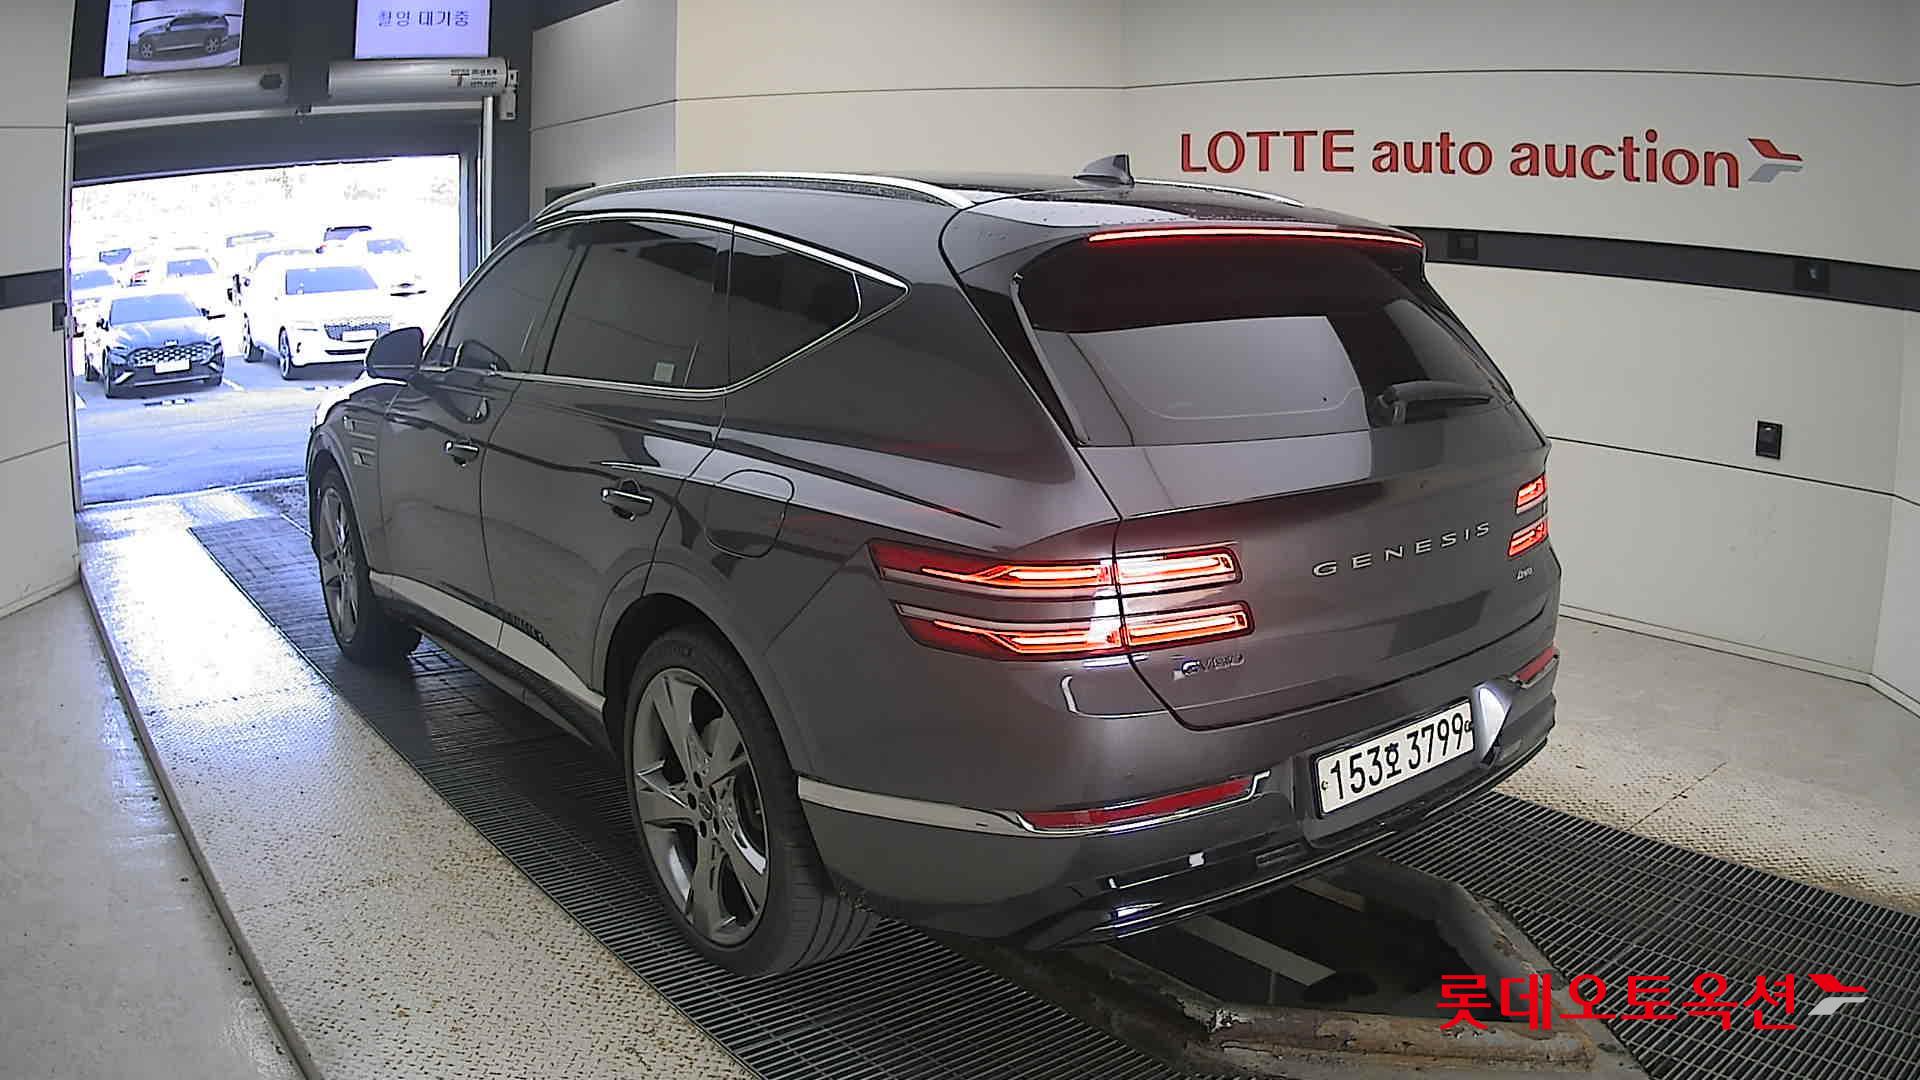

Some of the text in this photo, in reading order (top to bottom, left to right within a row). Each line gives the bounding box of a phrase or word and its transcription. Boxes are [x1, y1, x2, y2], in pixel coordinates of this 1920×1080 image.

[418, 10, 469, 27] 대기중
[1180, 128, 1740, 189] LOTTE auto auction
[1312, 522, 1490, 577] GENESIS
[1330, 712, 1464, 799] 153호 3799
